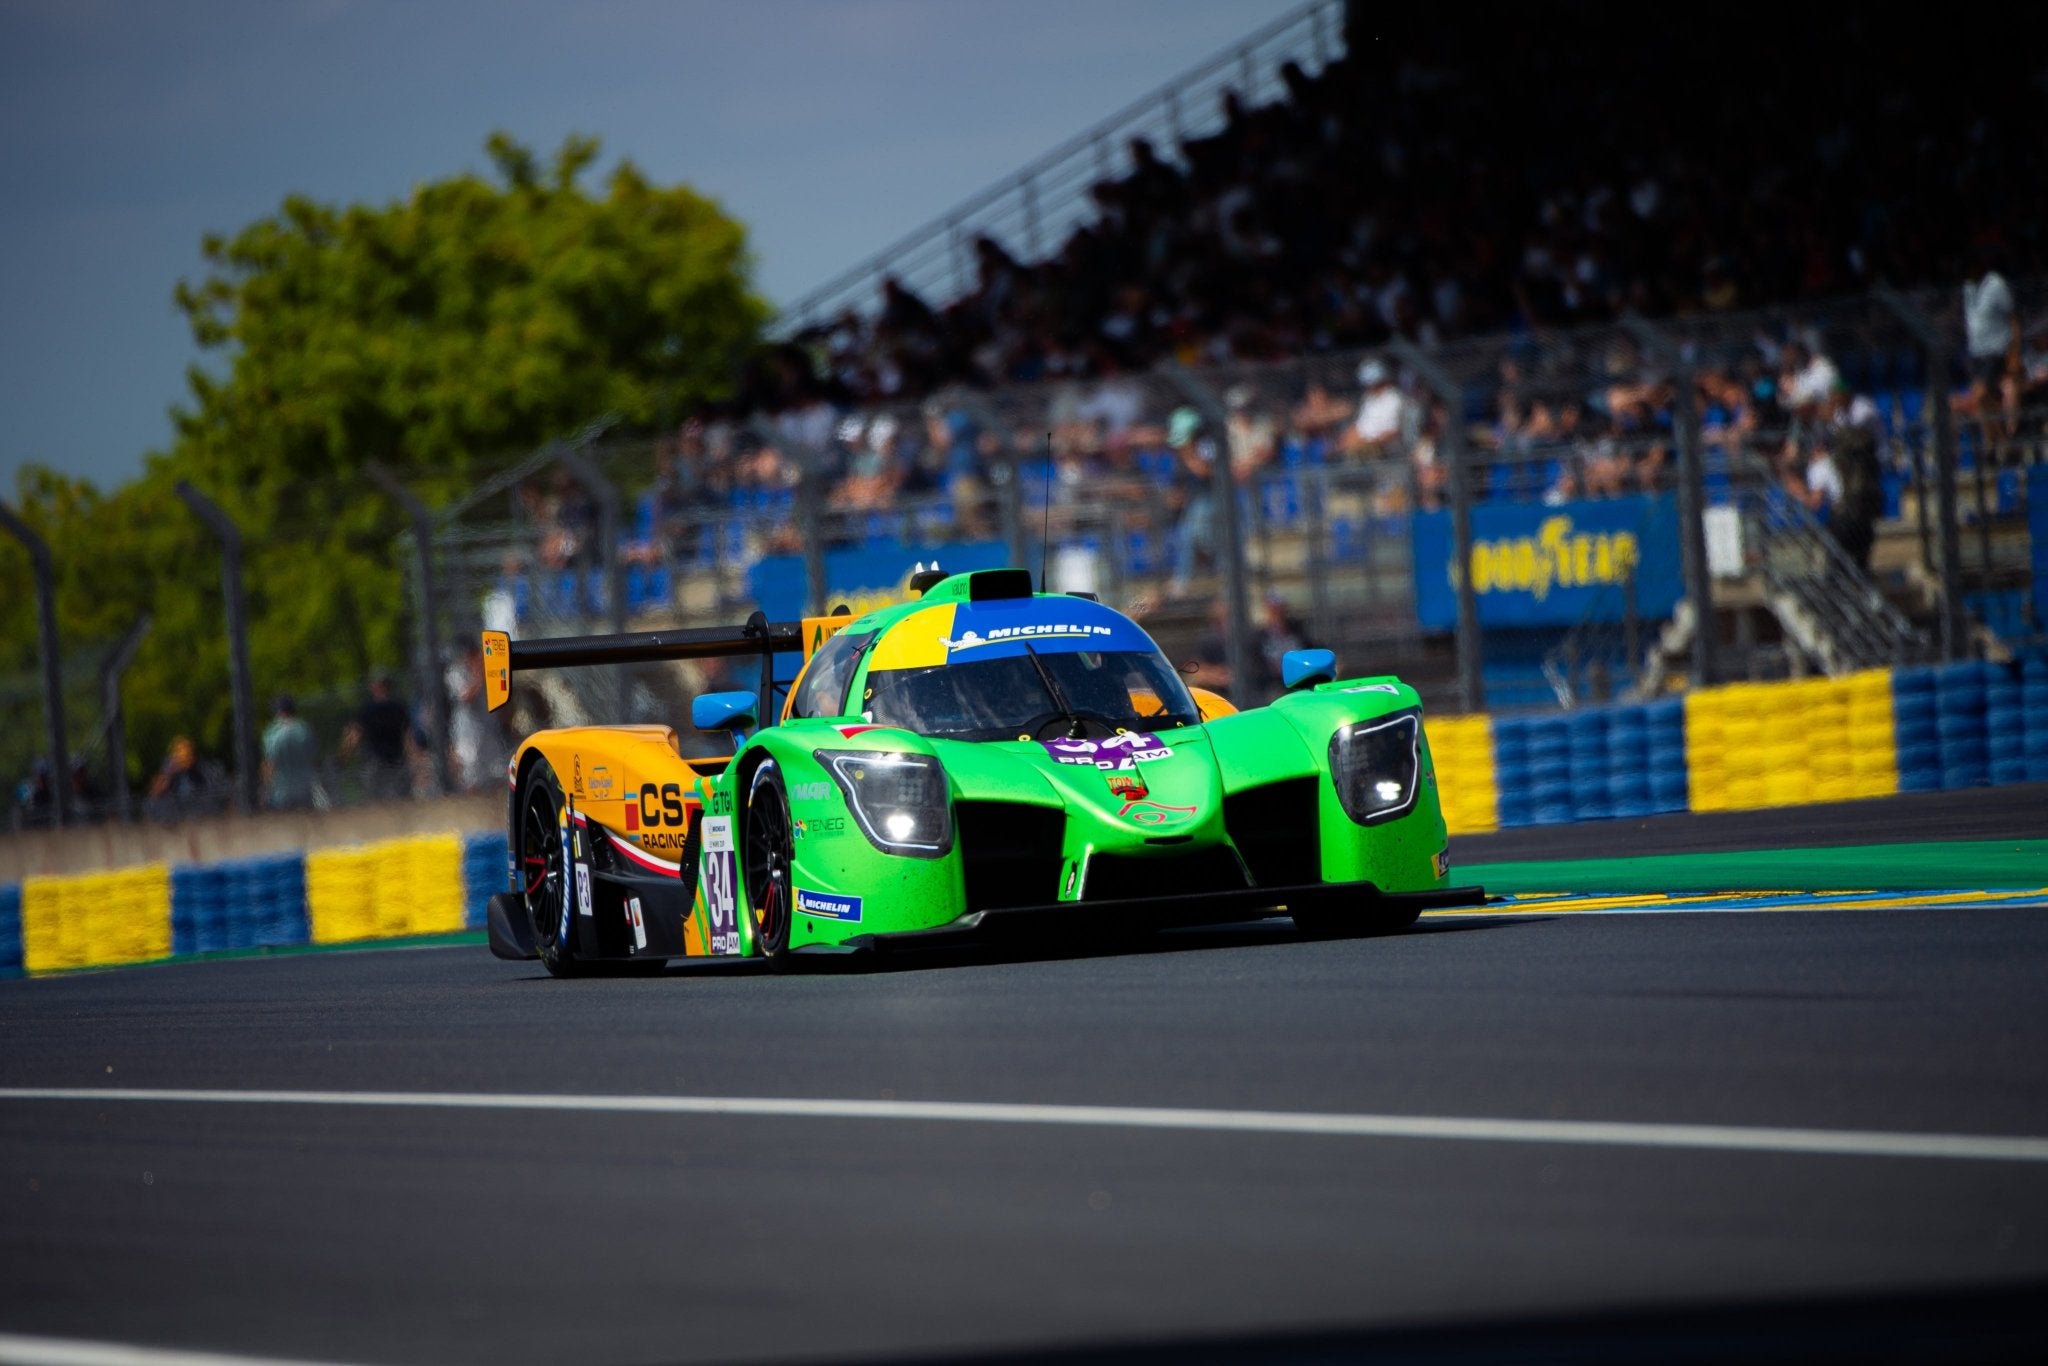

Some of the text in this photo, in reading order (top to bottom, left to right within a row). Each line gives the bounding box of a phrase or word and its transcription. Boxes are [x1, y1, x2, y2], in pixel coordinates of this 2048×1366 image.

[988, 624, 1112, 640] MICHELIN
[1057, 756, 1114, 771] PRO
[1107, 776, 1133, 789] TOW
[640, 783, 684, 828] CS
[806, 817, 845, 832] TENEG
[642, 833, 687, 849] RACING
[560, 846, 571, 940] MICHELIN
[576, 870, 590, 909] P3
[708, 851, 734, 928] 34
[806, 899, 851, 914] MICHELIN
[712, 935, 739, 951] PRO AM
